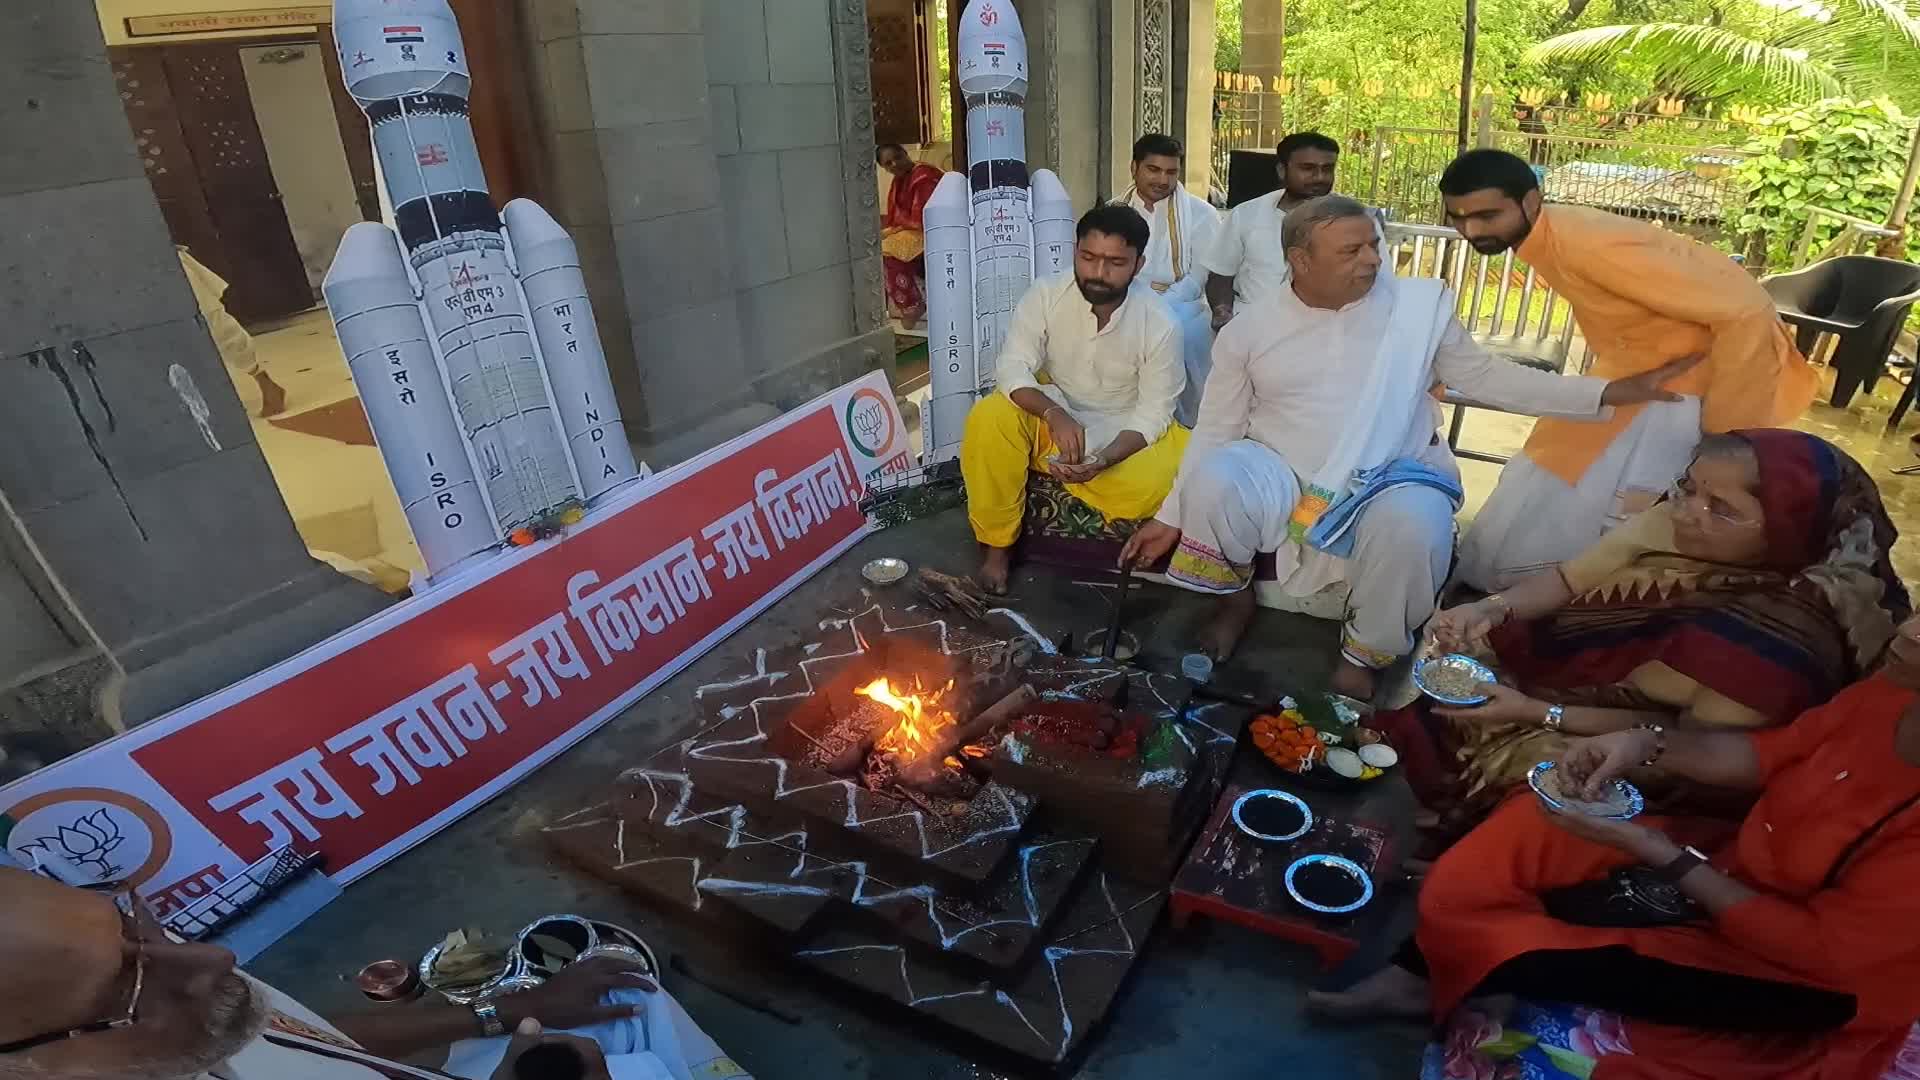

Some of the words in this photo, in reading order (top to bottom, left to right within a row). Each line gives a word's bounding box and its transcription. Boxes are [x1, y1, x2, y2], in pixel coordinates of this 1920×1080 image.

[948, 320, 960, 374] ISRO
[583, 392, 616, 479] INDIA
[426, 452, 463, 529] ISRO
[207, 746, 364, 853] जय
